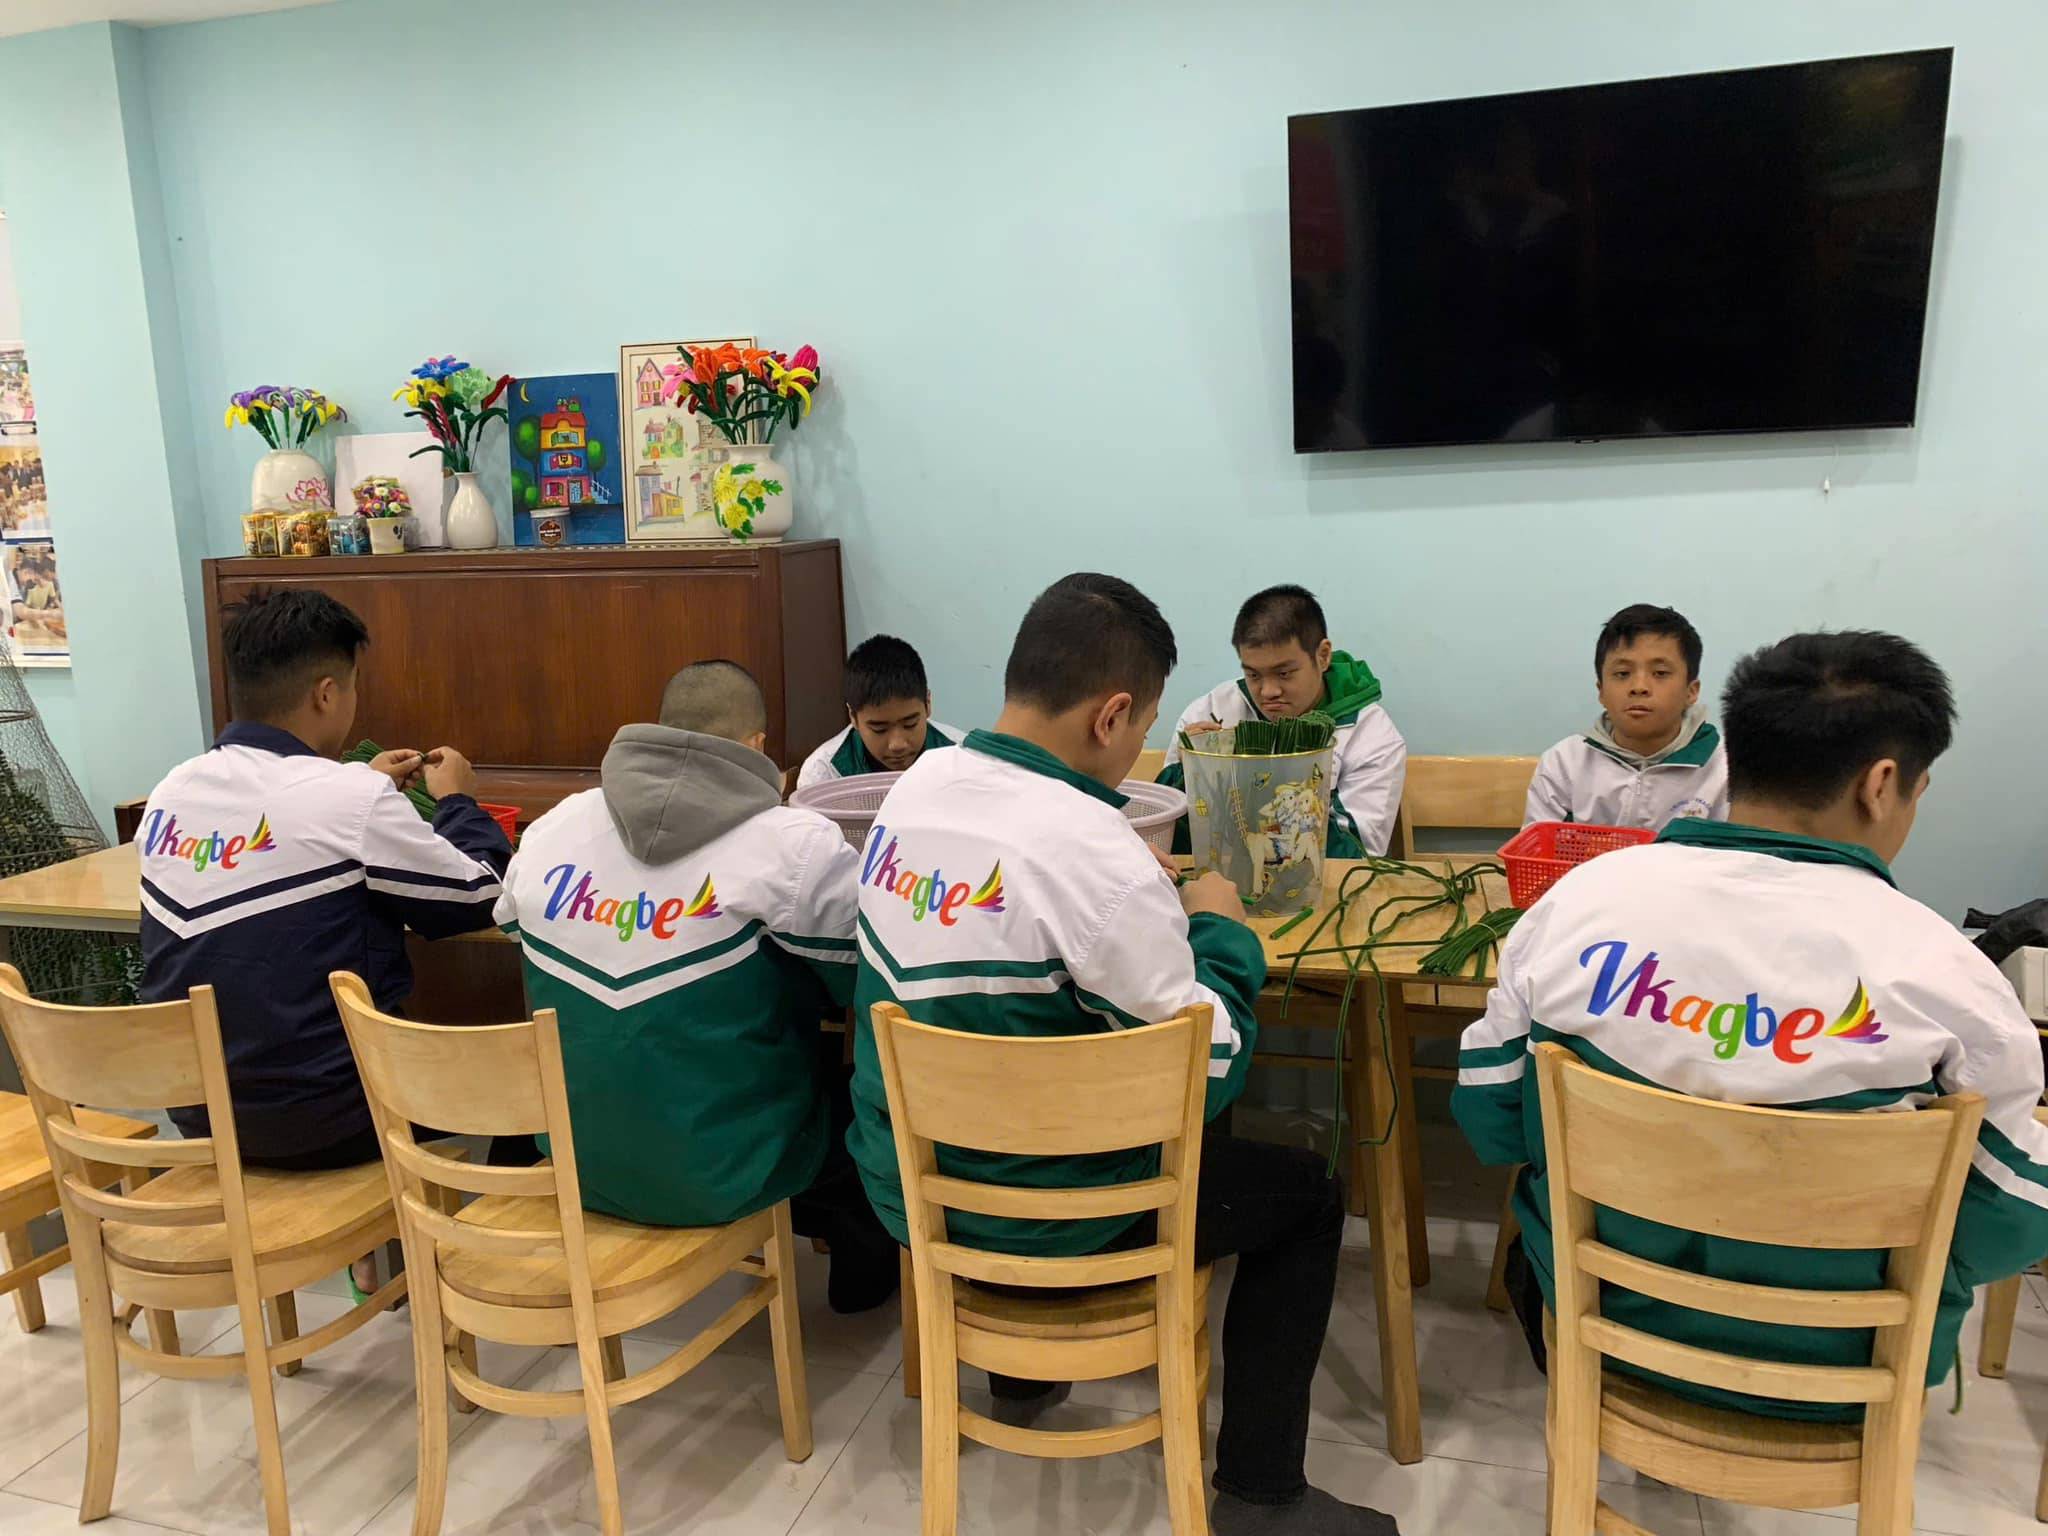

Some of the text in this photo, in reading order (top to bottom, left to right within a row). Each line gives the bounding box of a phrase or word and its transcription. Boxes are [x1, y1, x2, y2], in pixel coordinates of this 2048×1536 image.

[144, 808, 246, 872] Vkagbe
[860, 824, 971, 926] Vkagbe
[543, 863, 685, 942] Vkagbe
[1579, 940, 1825, 1064] Vkagbe
